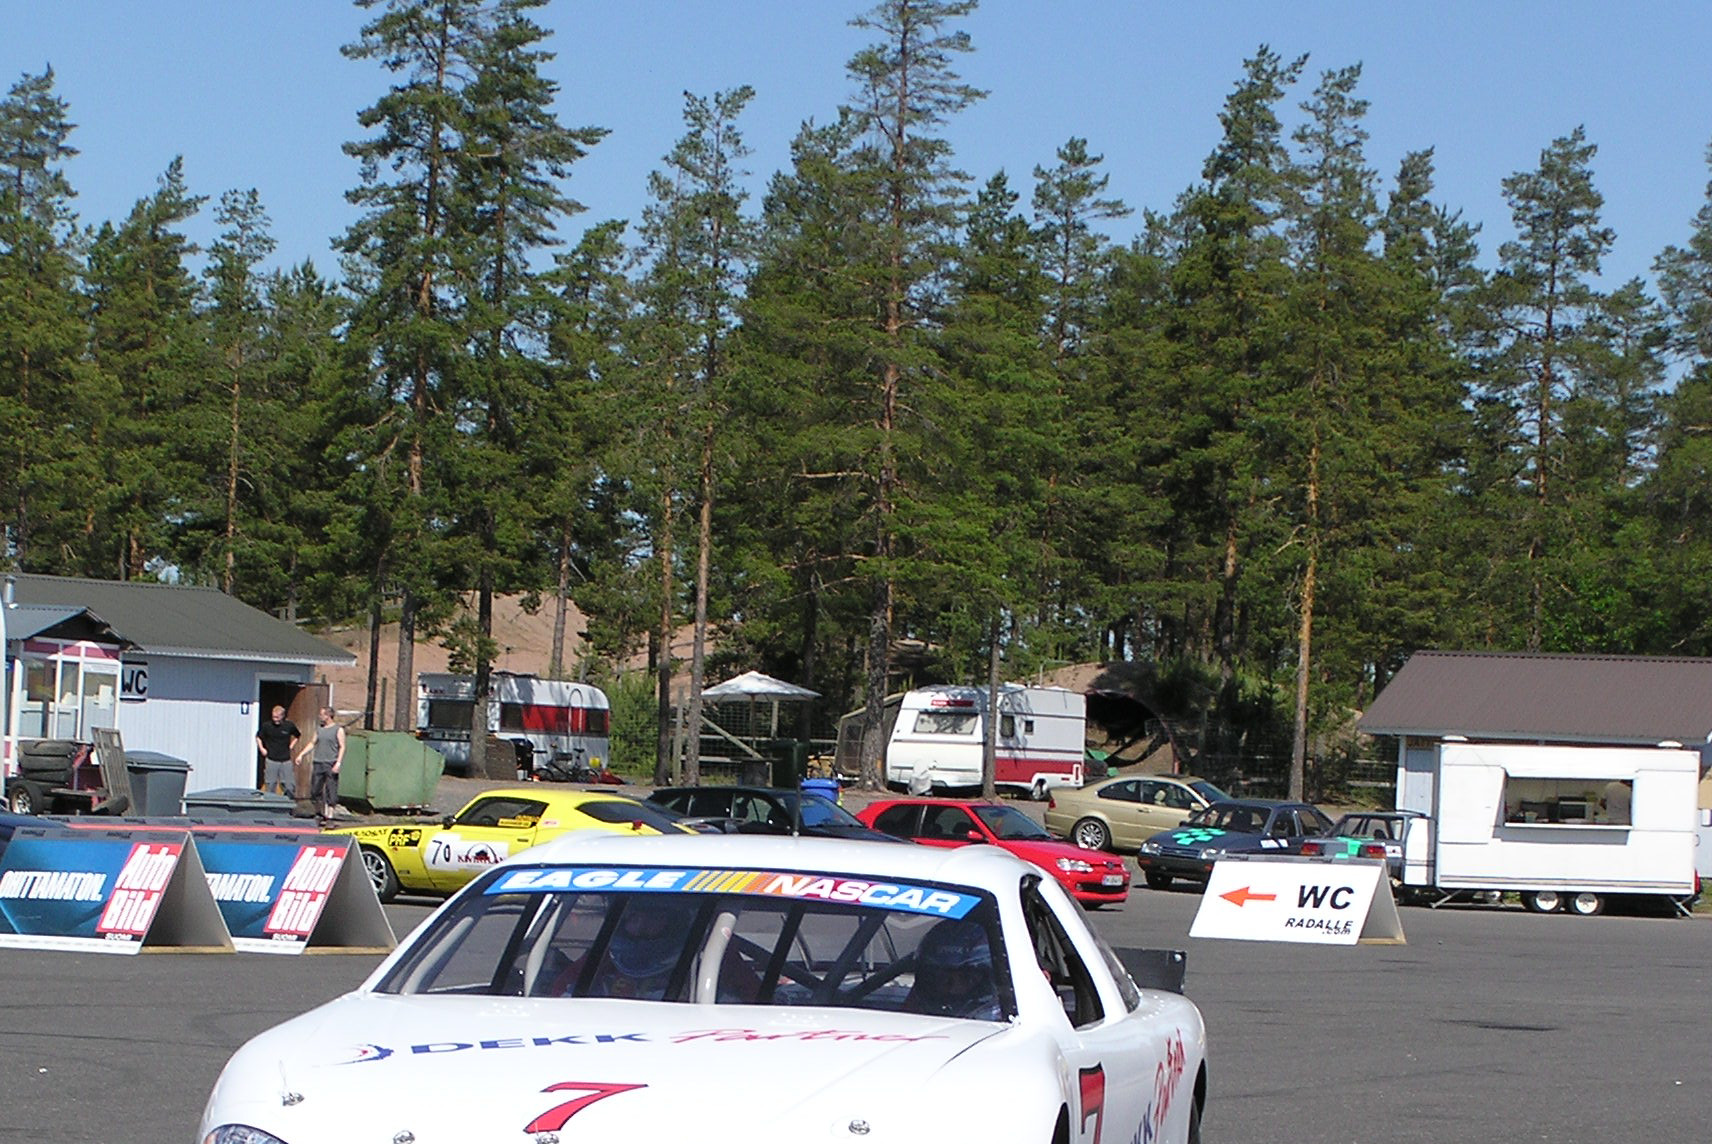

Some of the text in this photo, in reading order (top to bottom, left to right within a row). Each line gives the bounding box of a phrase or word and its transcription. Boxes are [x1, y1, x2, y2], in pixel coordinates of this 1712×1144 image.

[121, 669, 147, 695] WC
[115, 844, 178, 891] Auto
[282, 847, 342, 892] Auto
[432, 840, 451, 865] 70
[100, 889, 161, 931] Bild
[268, 891, 326, 932] Bild
[500, 870, 960, 913] EAGLE NASCAR
[1297, 885, 1355, 910] WC
[1284, 917, 1354, 930] RADALLE
[410, 1033, 653, 1054] DEKK
[522, 1081, 649, 1135] 7
